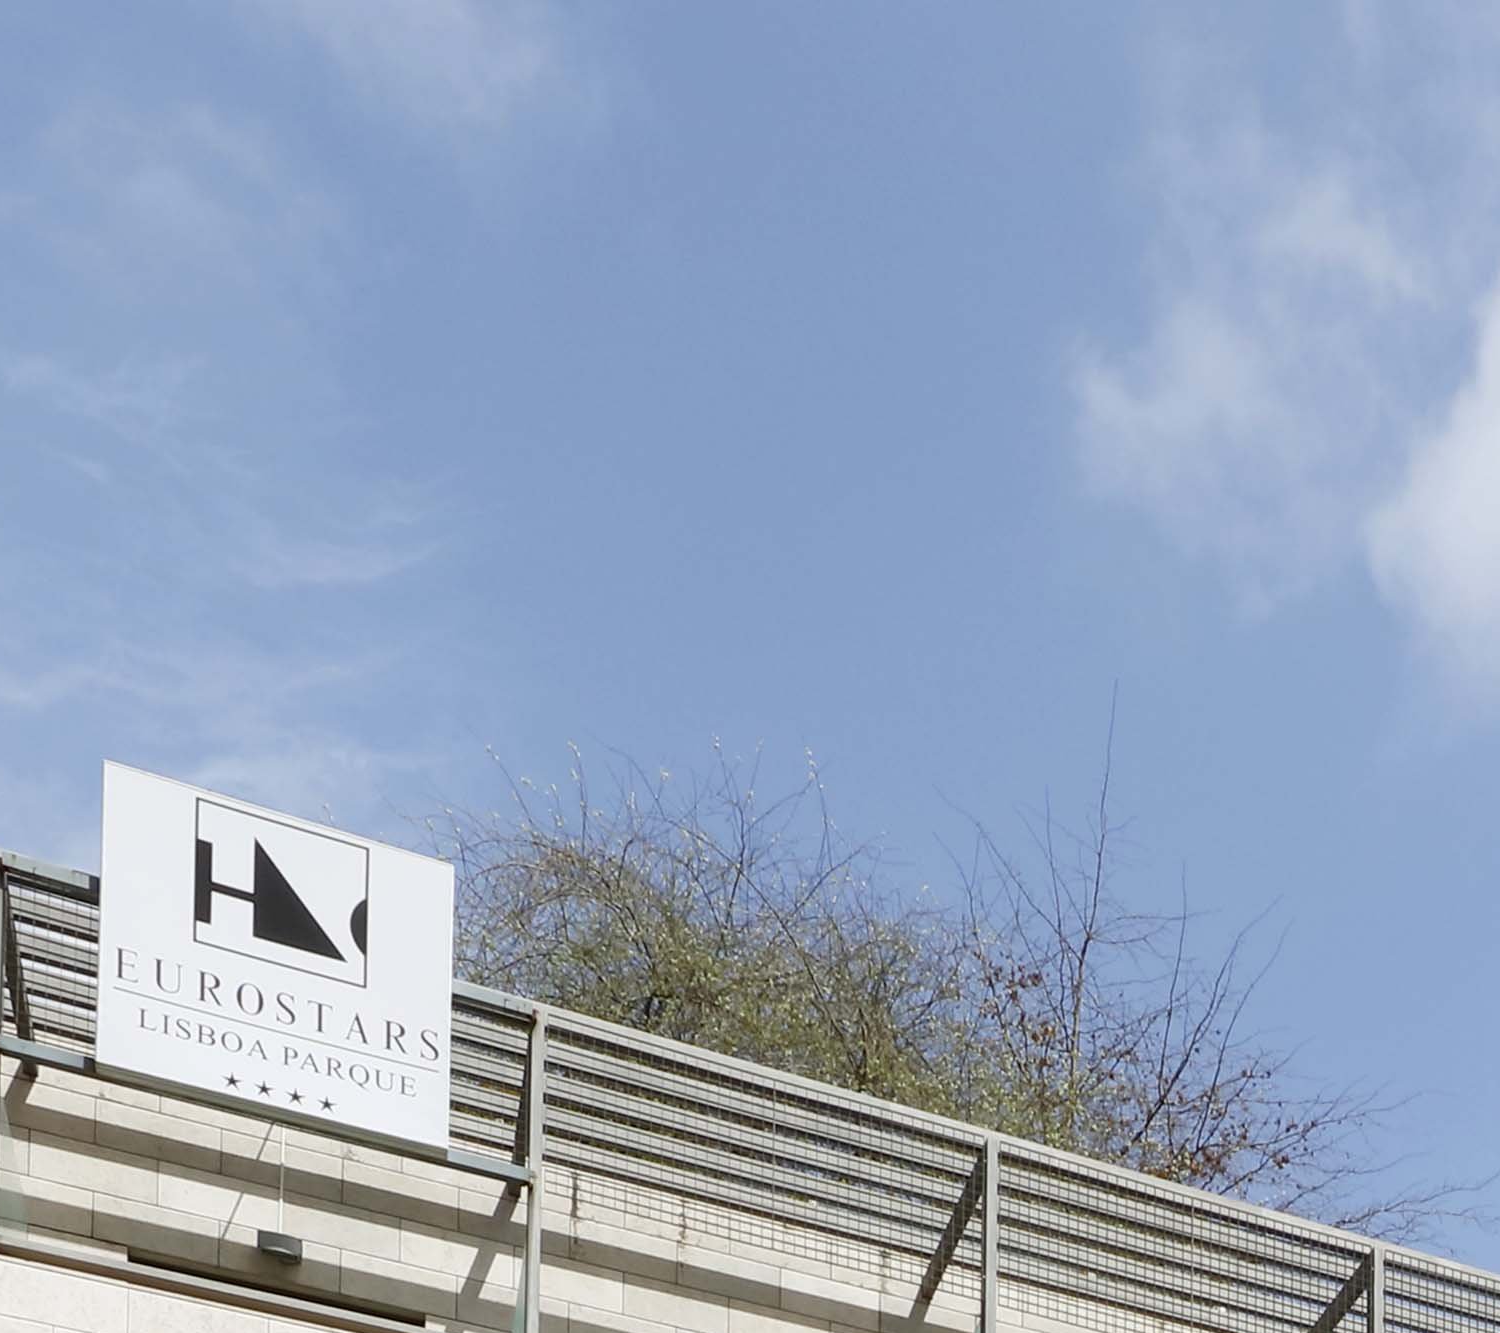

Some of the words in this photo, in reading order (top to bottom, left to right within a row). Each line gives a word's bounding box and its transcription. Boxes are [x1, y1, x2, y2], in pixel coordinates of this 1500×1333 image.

[115, 948, 440, 1061] EUROSTARS
[139, 1008, 269, 1061] LISBOA
[284, 1046, 417, 1098] PARQUE
